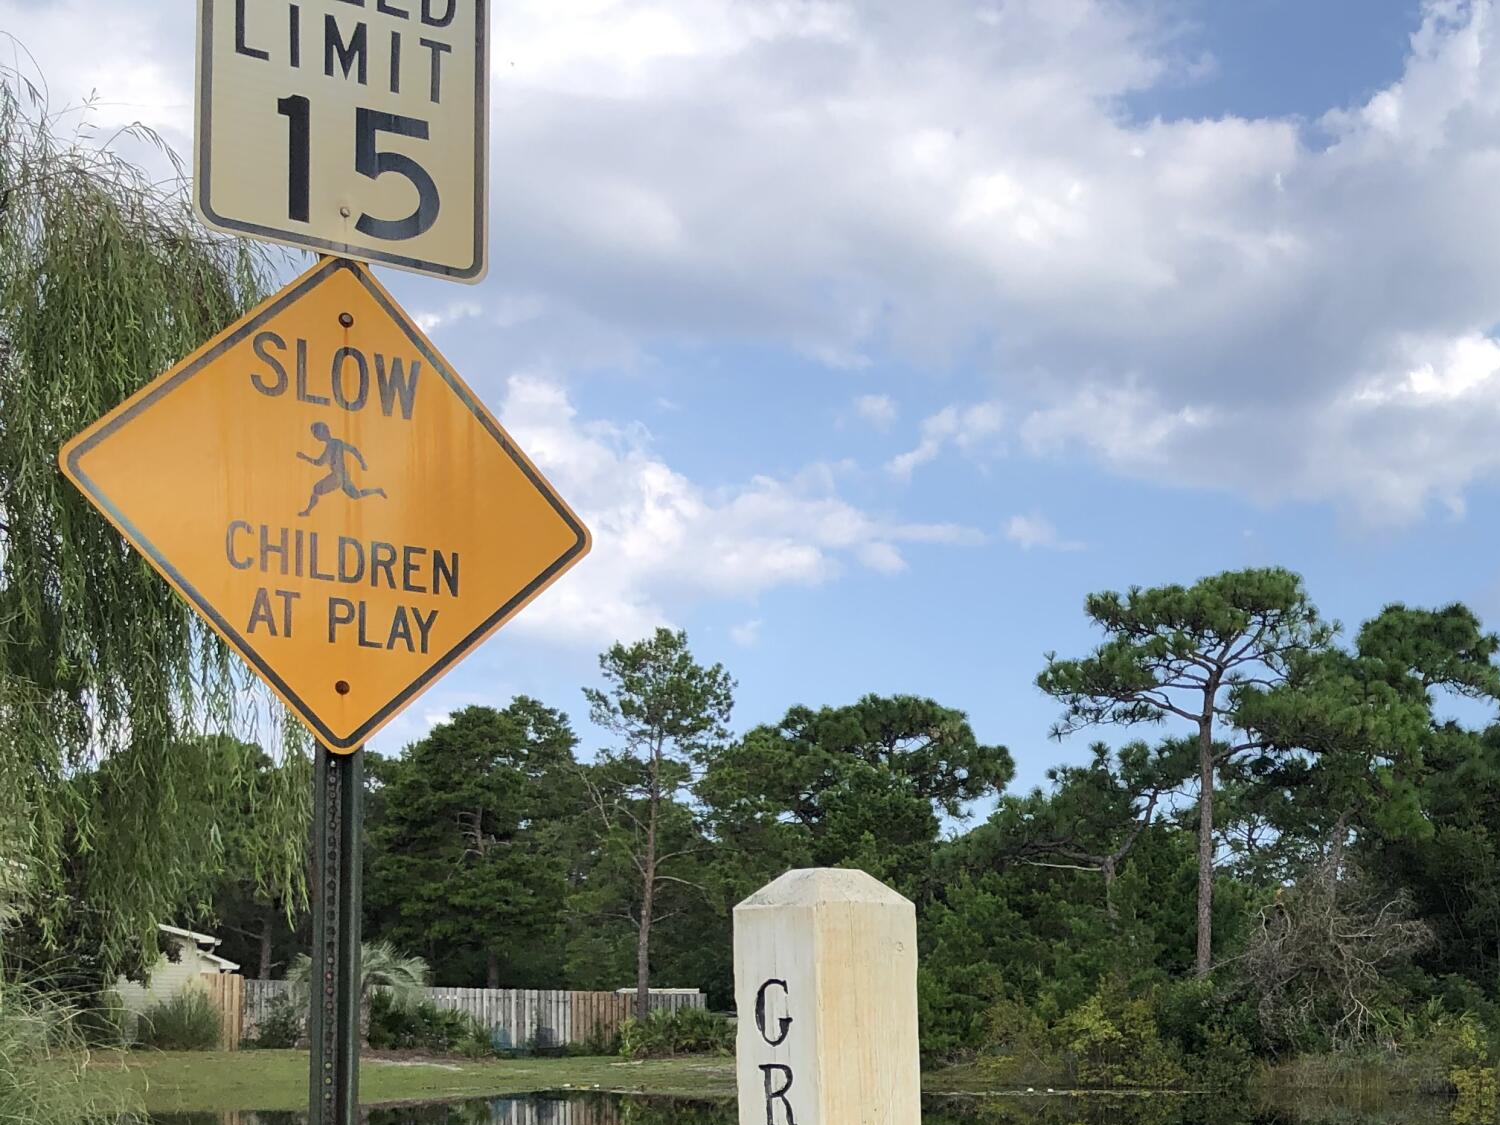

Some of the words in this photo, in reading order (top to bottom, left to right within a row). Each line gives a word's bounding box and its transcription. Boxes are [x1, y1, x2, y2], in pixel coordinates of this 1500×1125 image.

[235, 0, 452, 104] LIMIT
[277, 94, 440, 241] 15
[250, 331, 421, 420] SLOW
[225, 519, 459, 598] CHILDREN
[246, 587, 301, 638] AT
[328, 597, 439, 654] PLAY
